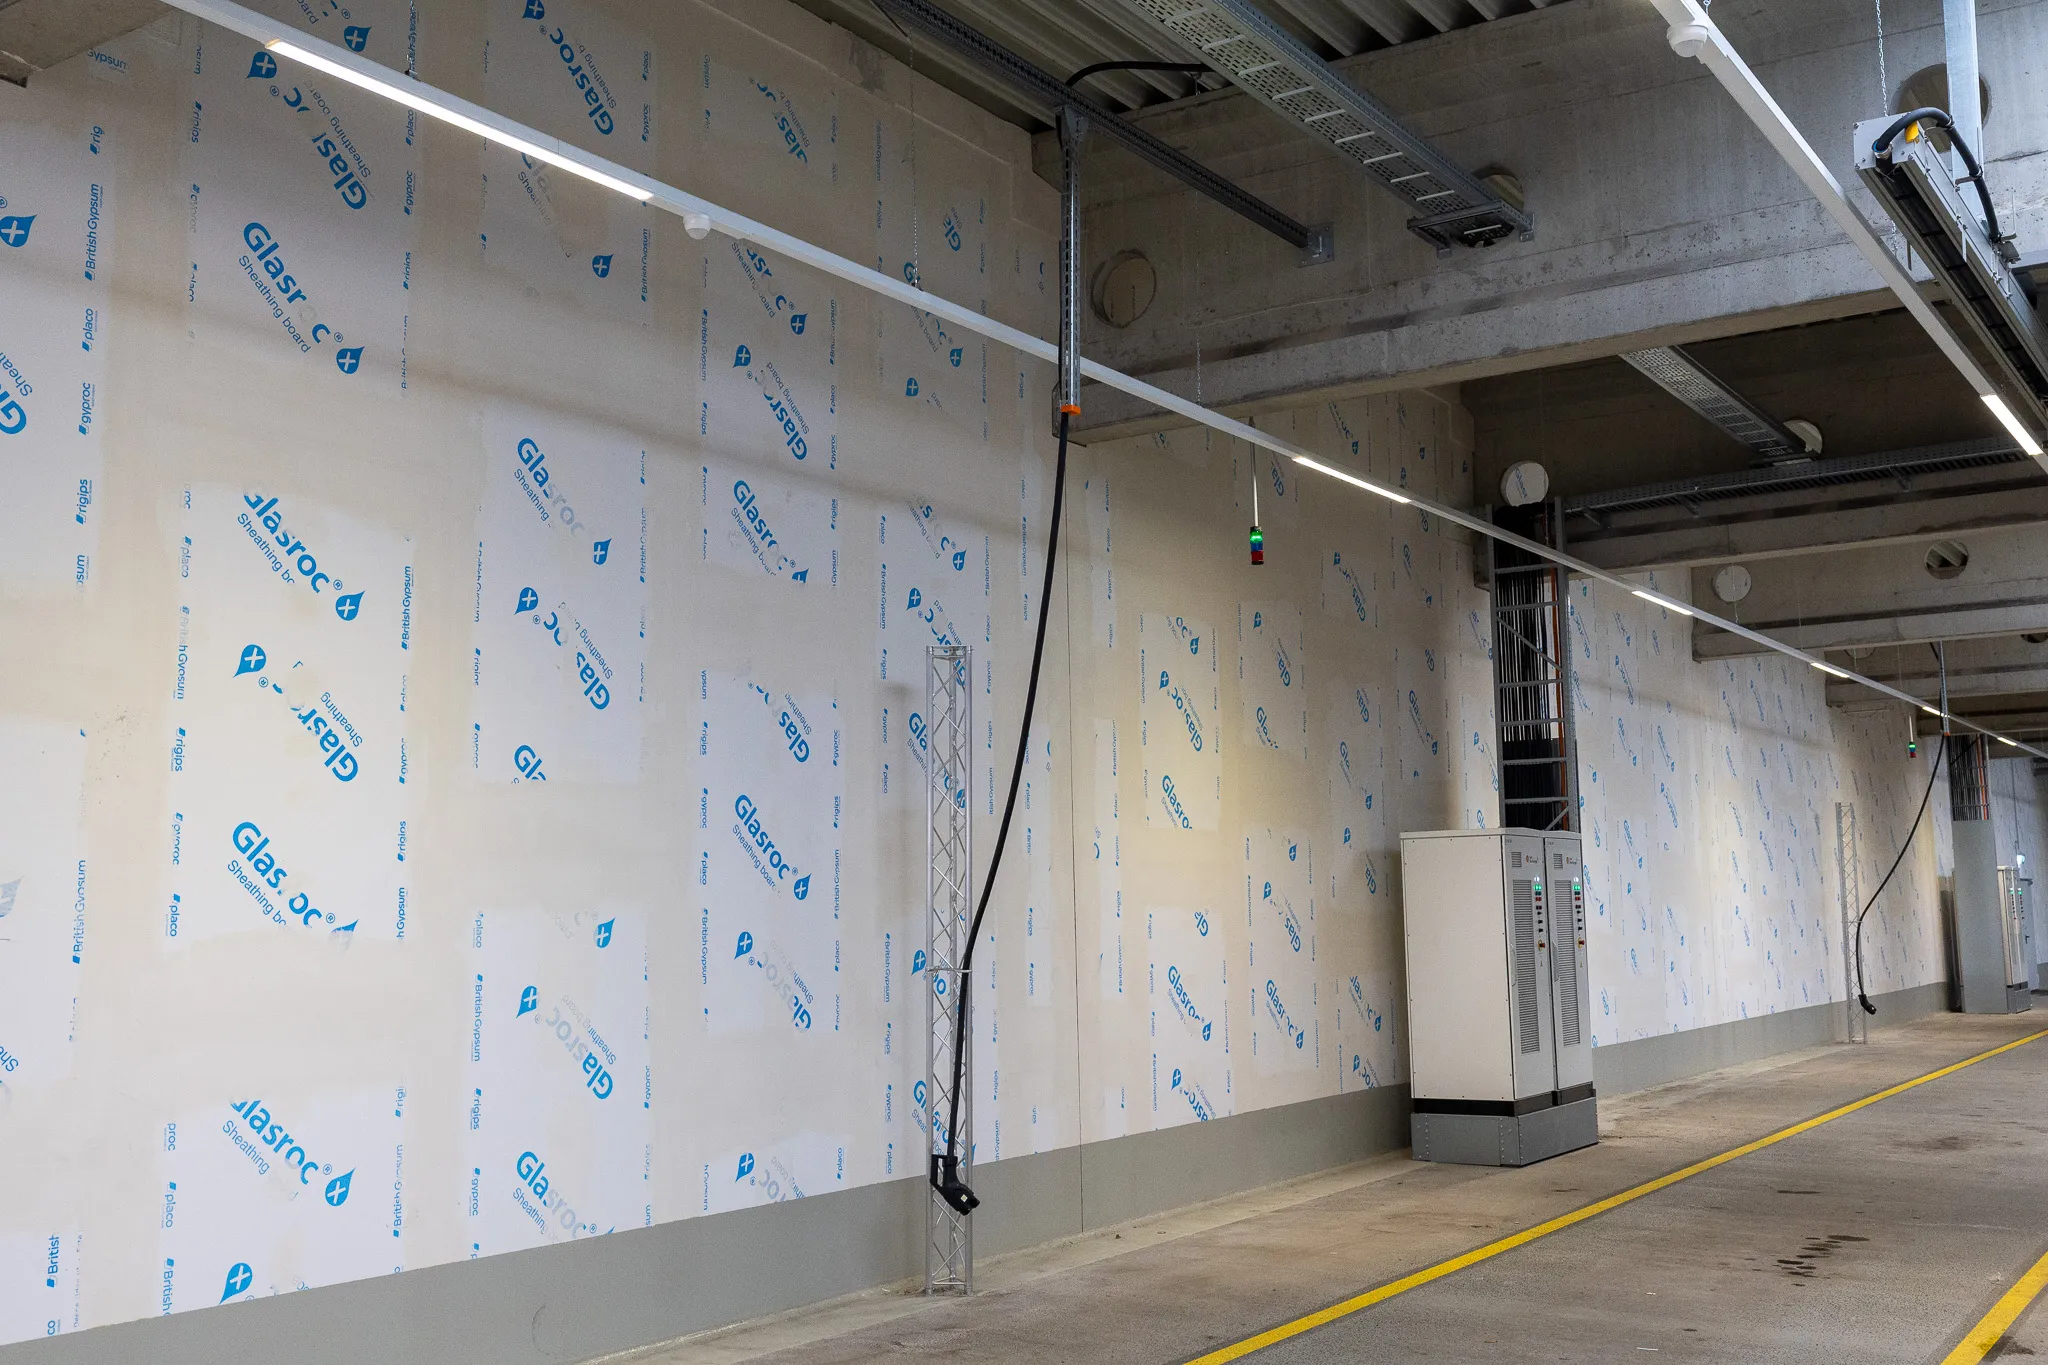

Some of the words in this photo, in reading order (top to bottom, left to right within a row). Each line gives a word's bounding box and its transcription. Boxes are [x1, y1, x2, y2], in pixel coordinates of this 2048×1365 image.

[298, 0, 319, 24] ard
[550, 28, 614, 136] Glasroc
[585, 52, 616, 108] Sheathing
[92, 126, 104, 143] rig
[785, 100, 810, 147] Sheathing
[329, 115, 372, 178] Sheathing
[88, 184, 100, 230] Gypsum
[405, 171, 414, 207] gyproc
[85, 231, 96, 270] British
[82, 308, 94, 341] placo
[240, 255, 283, 320] Sheathing
[282, 313, 311, 354] board
[767, 362, 784, 390] board
[82, 382, 92, 424] gyproc
[784, 390, 809, 434] Sheathing
[78, 479, 88, 512] rigips
[514, 469, 549, 521] Sheathing
[238, 513, 282, 572] Sheathing
[732, 508, 759, 553] Sheathing
[403, 566, 411, 608] Gypsum
[402, 608, 411, 640] British
[580, 628, 612, 679] Sheathing
[272, 684, 358, 782] Glasr
[320, 692, 362, 747] Sheathing
[174, 738, 185, 772] rigips
[1162, 775, 1192, 829] Glasro
[733, 824, 760, 869] Sheathing
[735, 795, 790, 880] Glasroc
[228, 860, 273, 916] Sheathing
[232, 822, 322, 928] Glasoc
[170, 904, 178, 936] placo
[396, 888, 405, 930] Gypsum
[74, 912, 84, 952] British
[474, 984, 482, 1017] British
[472, 1018, 482, 1062] Gypsum
[396, 1088, 405, 1109] rigi
[472, 1098, 480, 1130] rigips
[167, 1123, 176, 1150] proc
[222, 1120, 270, 1175] Sheathing
[165, 1193, 174, 1228] placo
[162, 1270, 173, 1311] British
